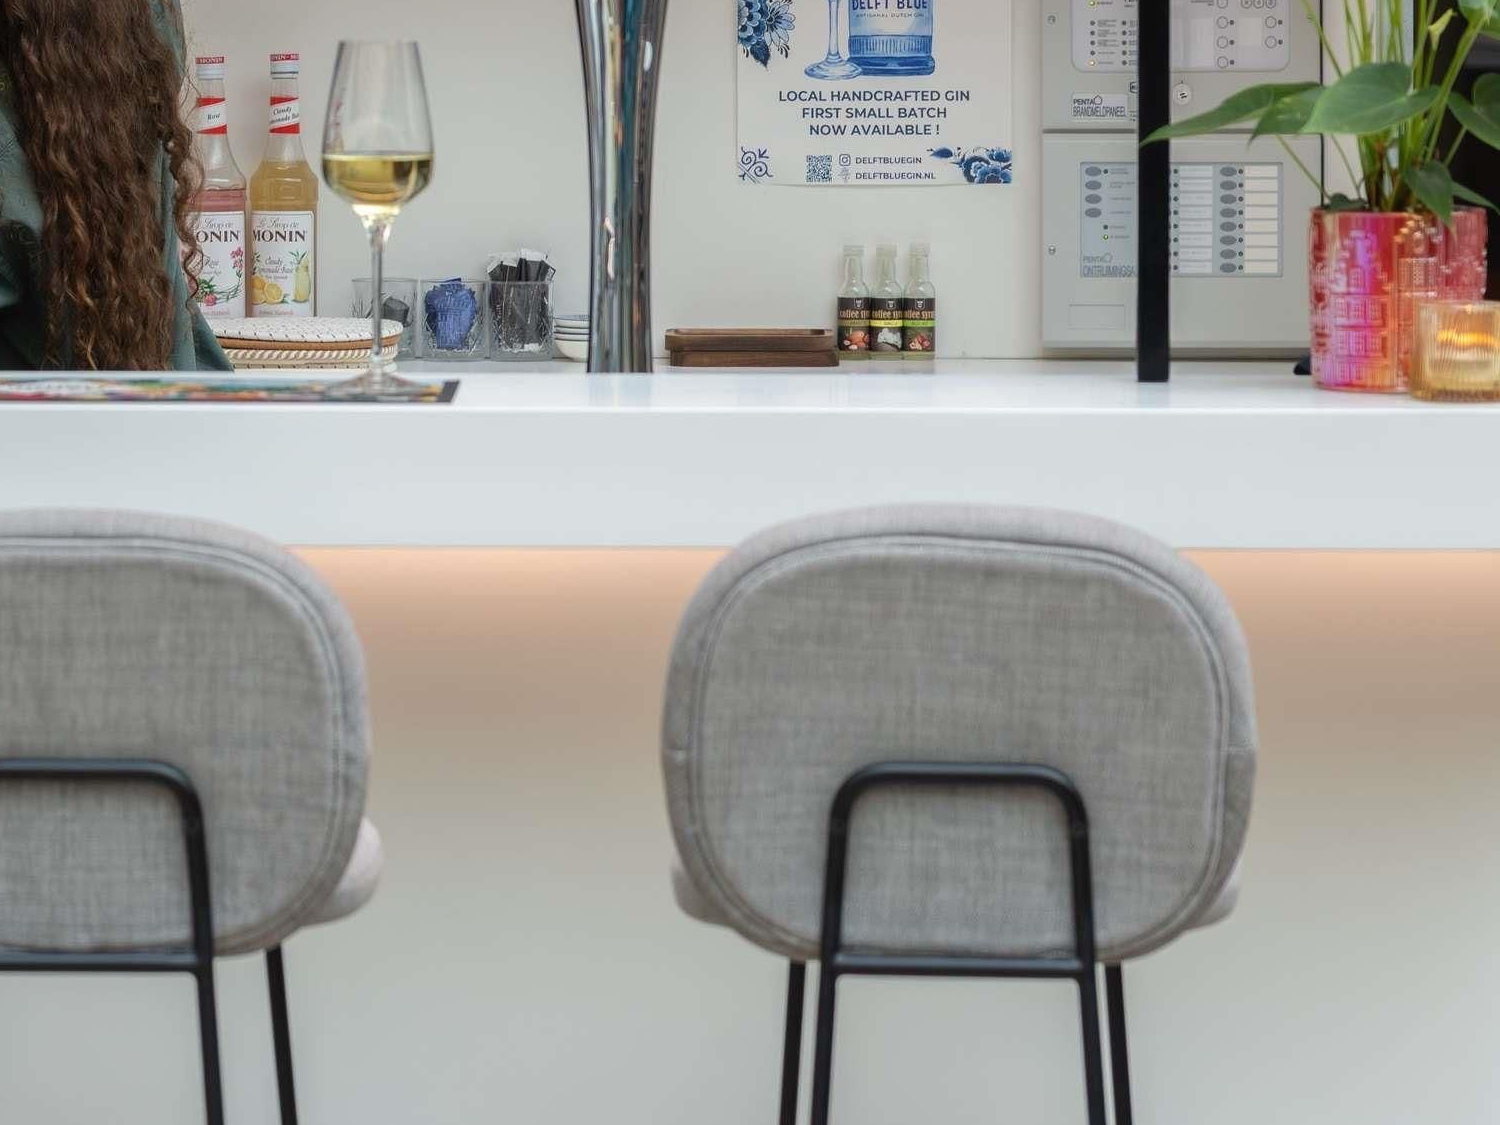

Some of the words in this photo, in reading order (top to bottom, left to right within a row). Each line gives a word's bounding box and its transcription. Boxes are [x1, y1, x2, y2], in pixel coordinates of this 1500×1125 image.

[779, 90, 827, 102] LOCAL
[831, 90, 940, 102] HANDCRAFTED
[944, 90, 970, 102] GIN
[802, 107, 841, 118] FIRST
[845, 107, 894, 118] SMALL
[898, 107, 947, 118] BATCH
[1073, 106, 1126, 117] BRANDMELDPANEEL
[809, 124, 846, 136] NOW
[850, 124, 932, 135] AVAILABLE
[935, 124, 940, 135] !
[855, 156, 922, 165] DELFTBLUEGIN
[855, 172, 936, 180] DELFTBLUEGIN.NL
[196, 230, 240, 243] ONIN
